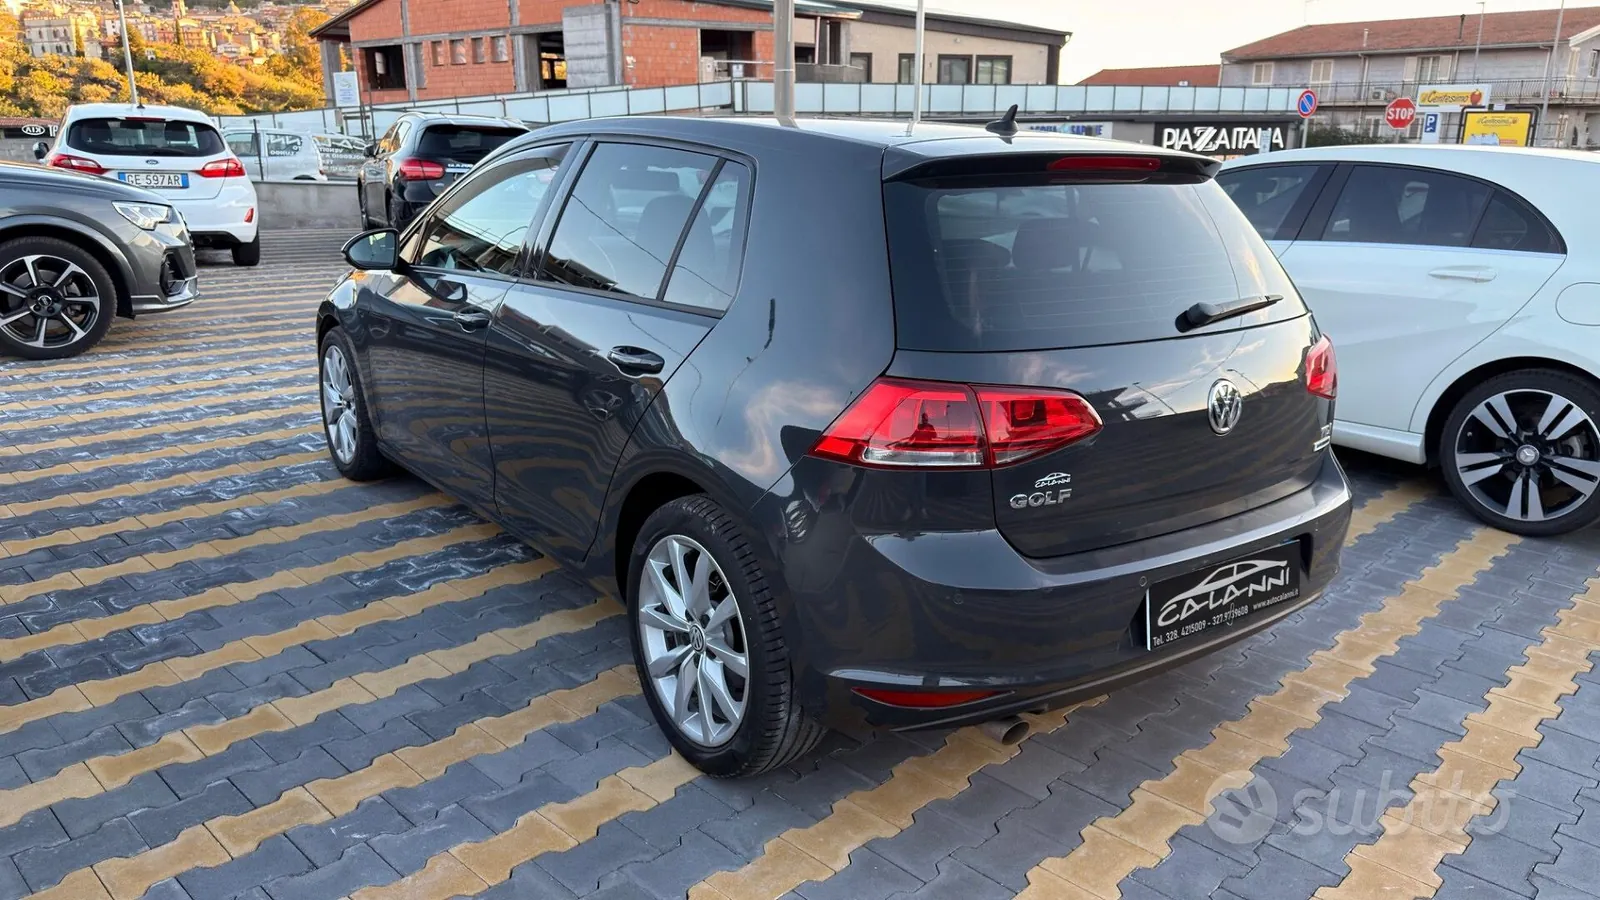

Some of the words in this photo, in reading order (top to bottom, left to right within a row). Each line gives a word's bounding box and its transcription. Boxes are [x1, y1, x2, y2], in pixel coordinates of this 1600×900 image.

[1387, 107, 1414, 120] STOP
[1427, 116, 1435, 128] P
[1071, 125, 1103, 135] SAPE
[127, 174, 141, 185] GE
[1010, 488, 1072, 509] GOLF
[1157, 567, 1290, 627] CALANNI
[1181, 620, 1206, 636] 4215009
[1252, 588, 1299, 611] www.autocalanni.it
